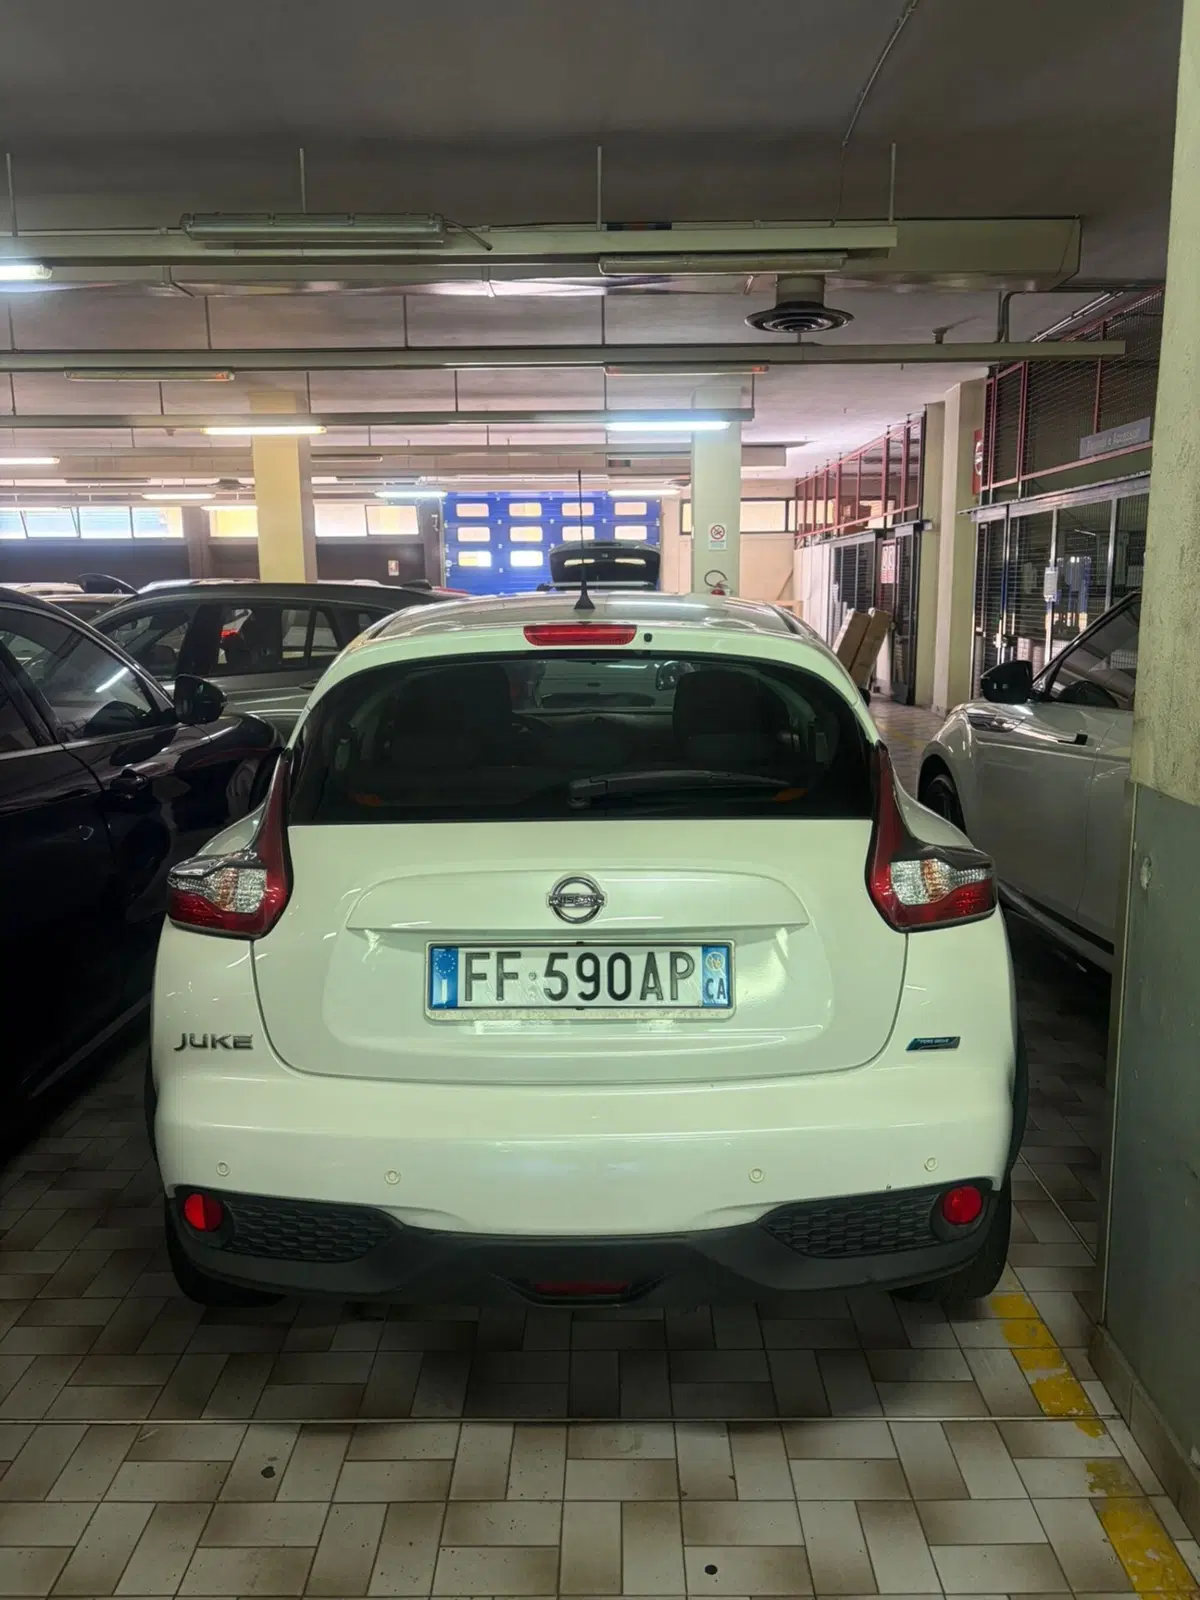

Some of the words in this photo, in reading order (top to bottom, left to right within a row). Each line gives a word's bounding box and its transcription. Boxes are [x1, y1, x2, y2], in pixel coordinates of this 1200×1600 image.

[464, 951, 522, 1002] FF
[543, 951, 695, 1002] 590AP
[705, 977, 727, 1000] CA
[173, 1032, 253, 1052] JUKE
